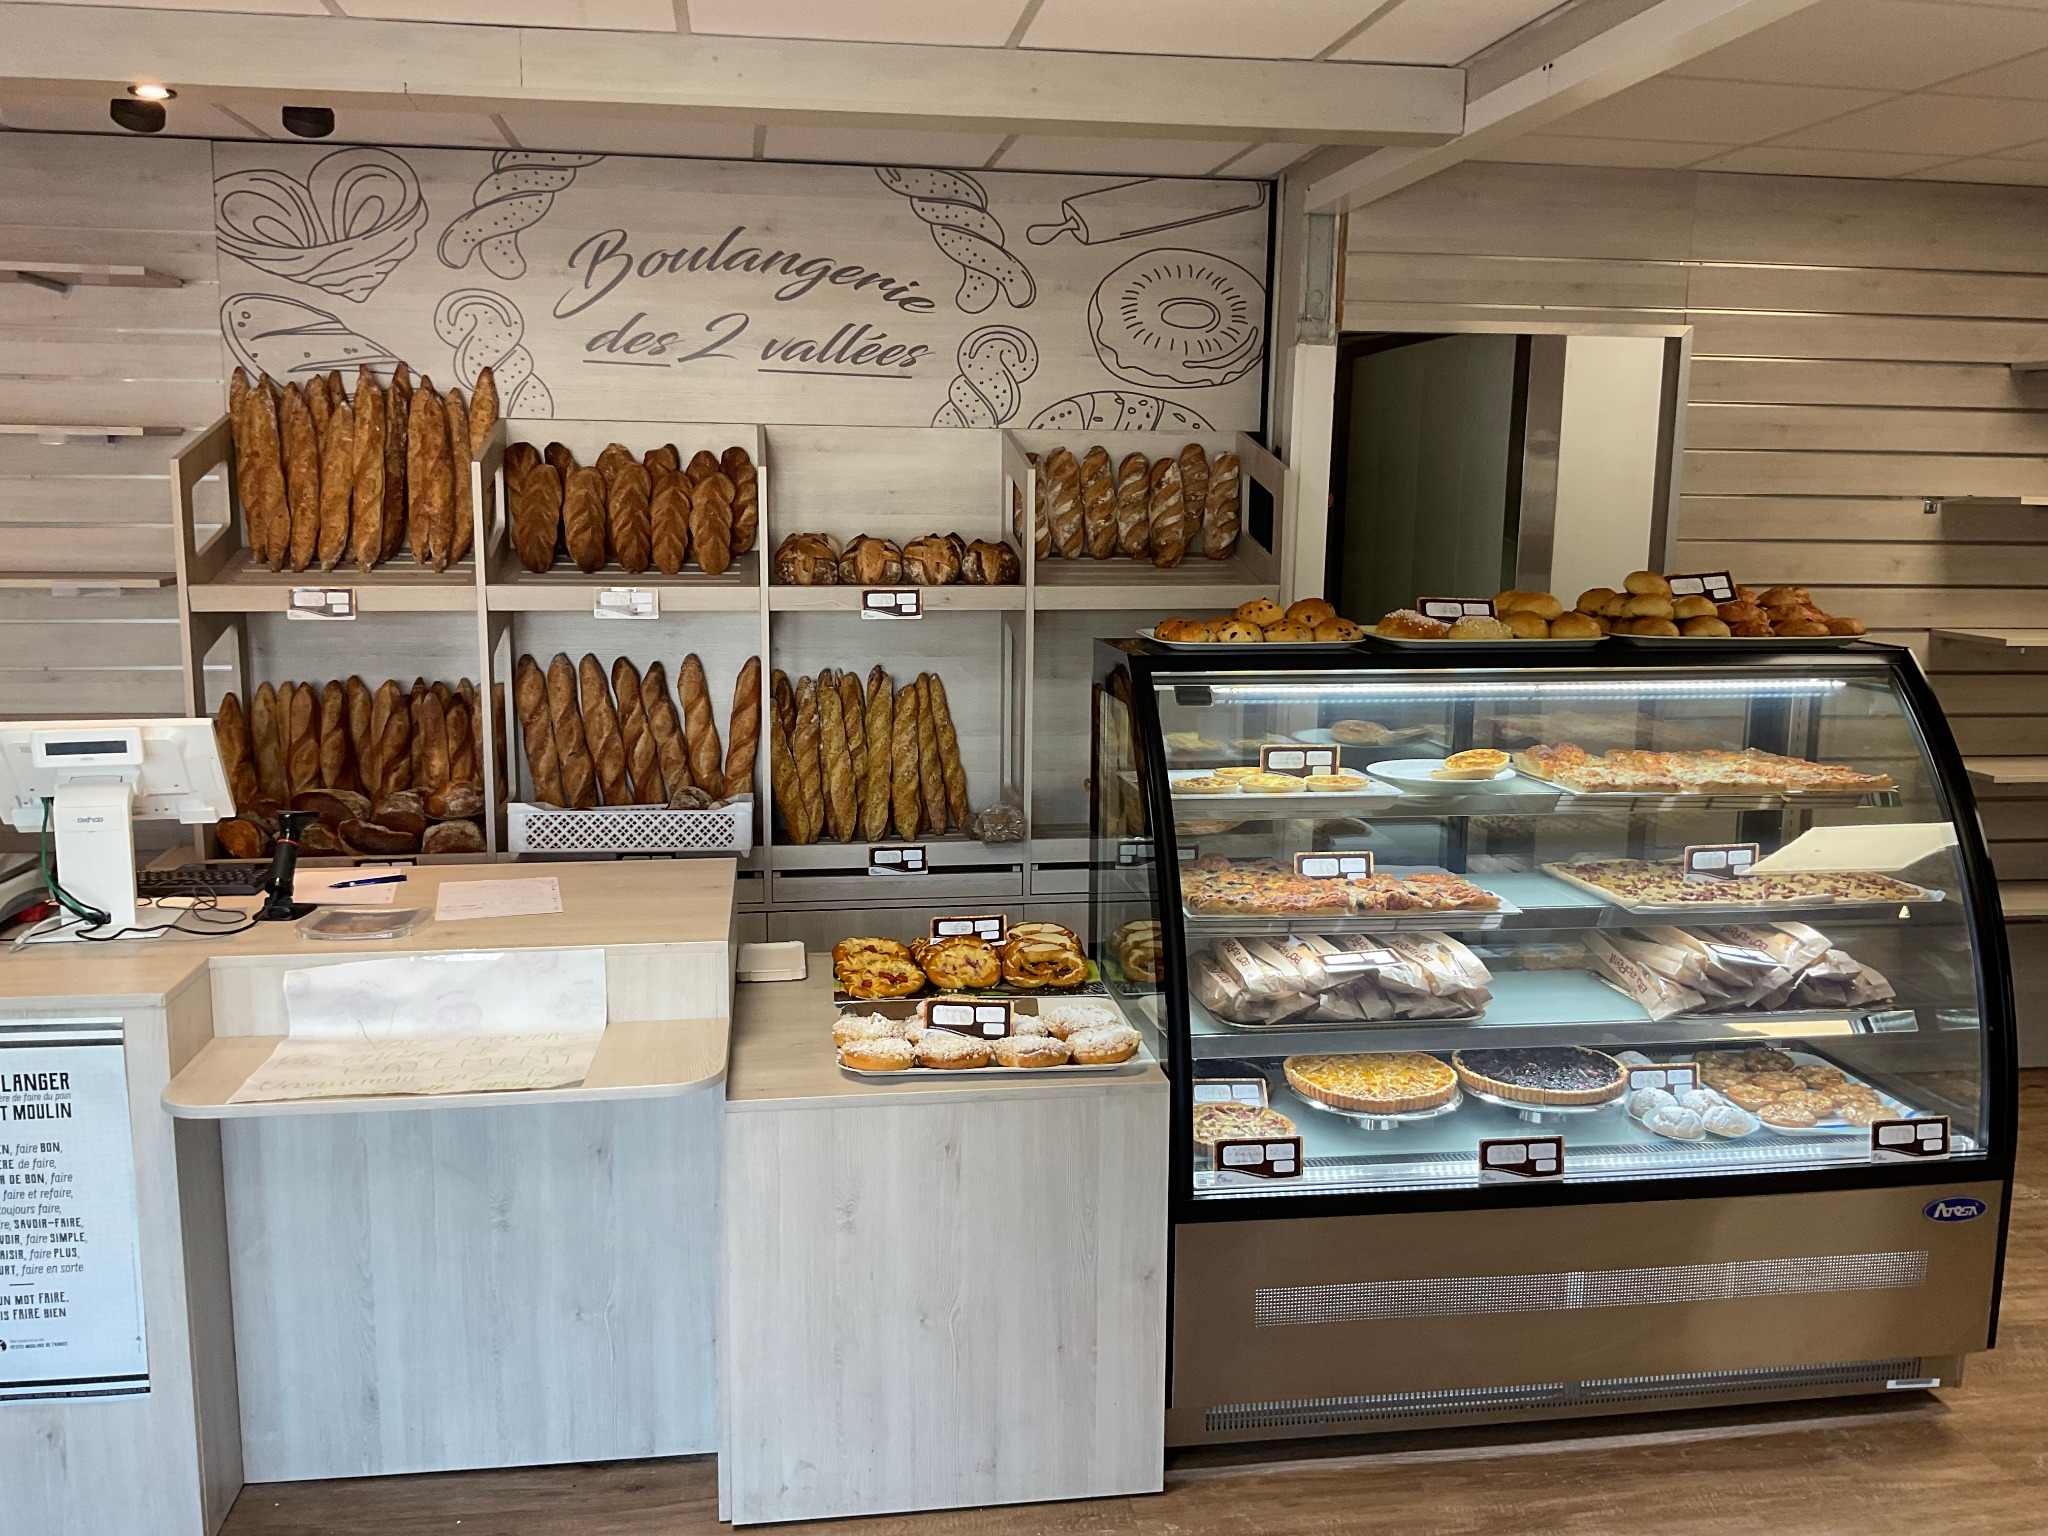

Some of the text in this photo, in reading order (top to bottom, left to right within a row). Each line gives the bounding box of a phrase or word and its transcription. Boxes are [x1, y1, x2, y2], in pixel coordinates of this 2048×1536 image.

[553, 226, 936, 319] Boulangerie
[585, 312, 936, 368] des 2 vallées
[1, 1073, 70, 1092] LANGER
[23, 1093, 41, 1102] faire
[13, 1103, 71, 1120] MOULIN
[15, 1144, 38, 1156] faire
[40, 1142, 63, 1153] BON,
[18, 1159, 29, 1169] de
[32, 1158, 56, 1170] faire,
[9, 1175, 21, 1184] DE
[50, 1173, 73, 1185] faire
[4, 1190, 25, 1201] faire
[28, 1190, 37, 1199] et
[25, 1234, 48, 1246] faire
[29, 1249, 52, 1261] faire
[54, 1248, 80, 1259] PLUS,
[21, 1265, 44, 1277] faire
[46, 1265, 58, 1273] en
[60, 1263, 84, 1273] sorte
[15, 1295, 34, 1305] MOT
[13, 1308, 40, 1320] FAIRE
[44, 1308, 66, 1318] BIEN
